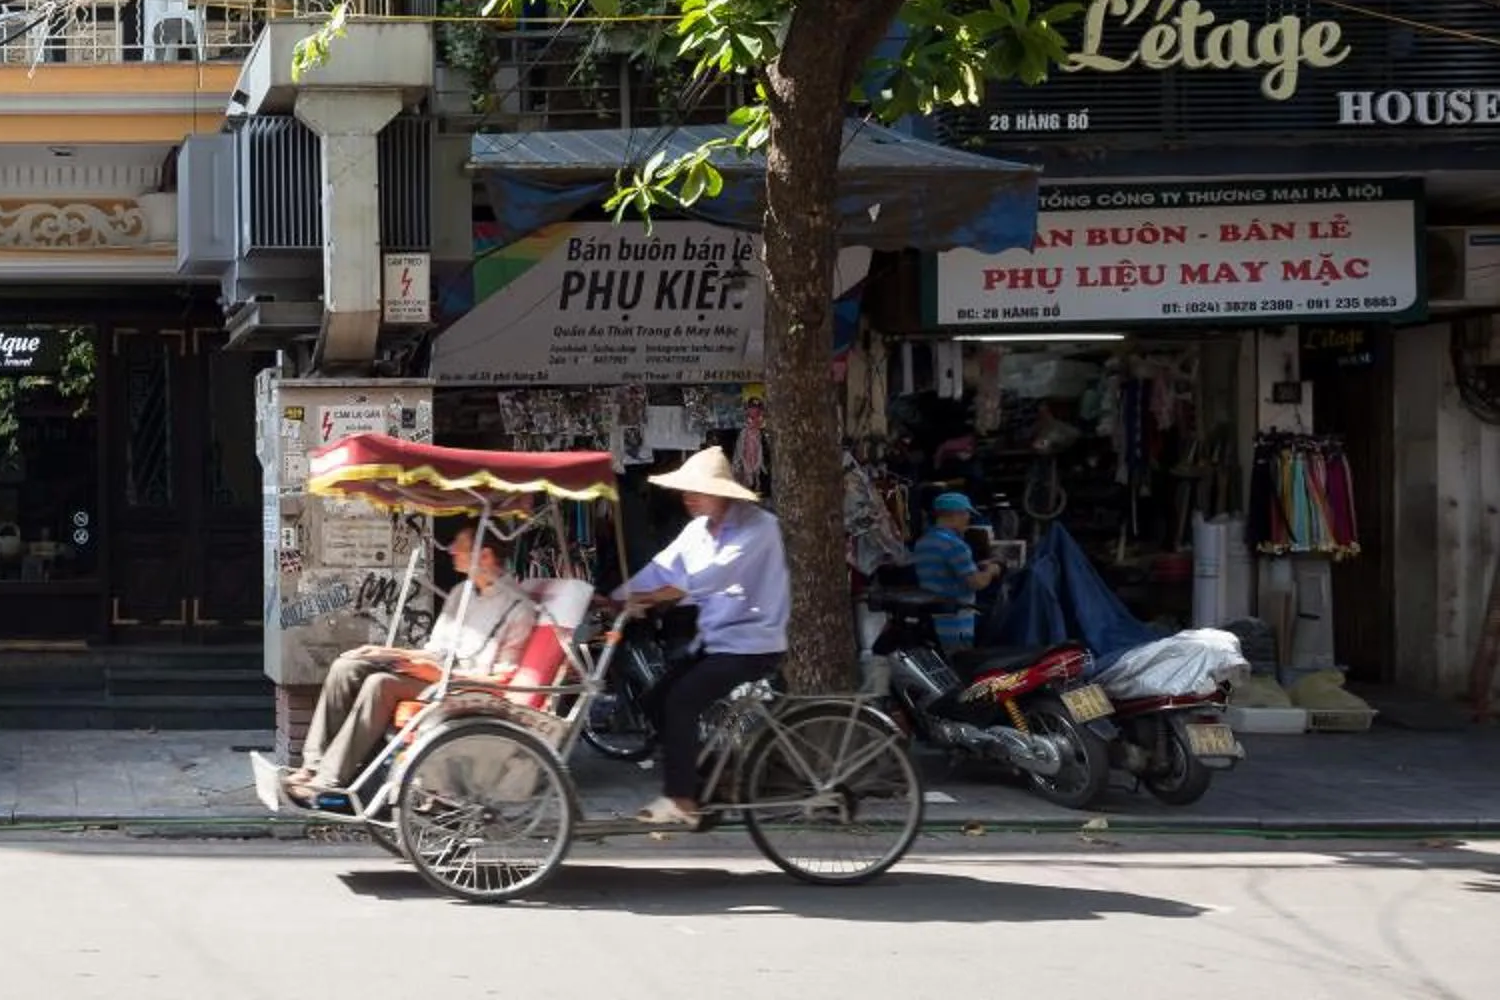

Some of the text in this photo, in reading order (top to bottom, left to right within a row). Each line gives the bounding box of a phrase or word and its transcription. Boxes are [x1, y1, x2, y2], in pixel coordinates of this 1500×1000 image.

[989, 114, 1009, 131] 28
[1015, 109, 1061, 131] HÀNG
[1337, 90, 1500, 124] HOUSE
[1039, 183, 1383, 208] TỔNG CÔNG TY THƯƠNG MẠI HÀ NỘI
[1086, 221, 1189, 247] BUÔN
[1219, 218, 1297, 243] BÁN
[1308, 212, 1352, 240] LẺ
[567, 236, 612, 262] Bán
[617, 236, 676, 262] buôn
[682, 236, 726, 262] bán
[981, 252, 1371, 295] PHỤ LIỆU MAY MẶC
[559, 269, 645, 322] PHỤ
[1185, 301, 1221, 314] (024)
[636, 326, 671, 339] Trang
[685, 326, 712, 339] May
